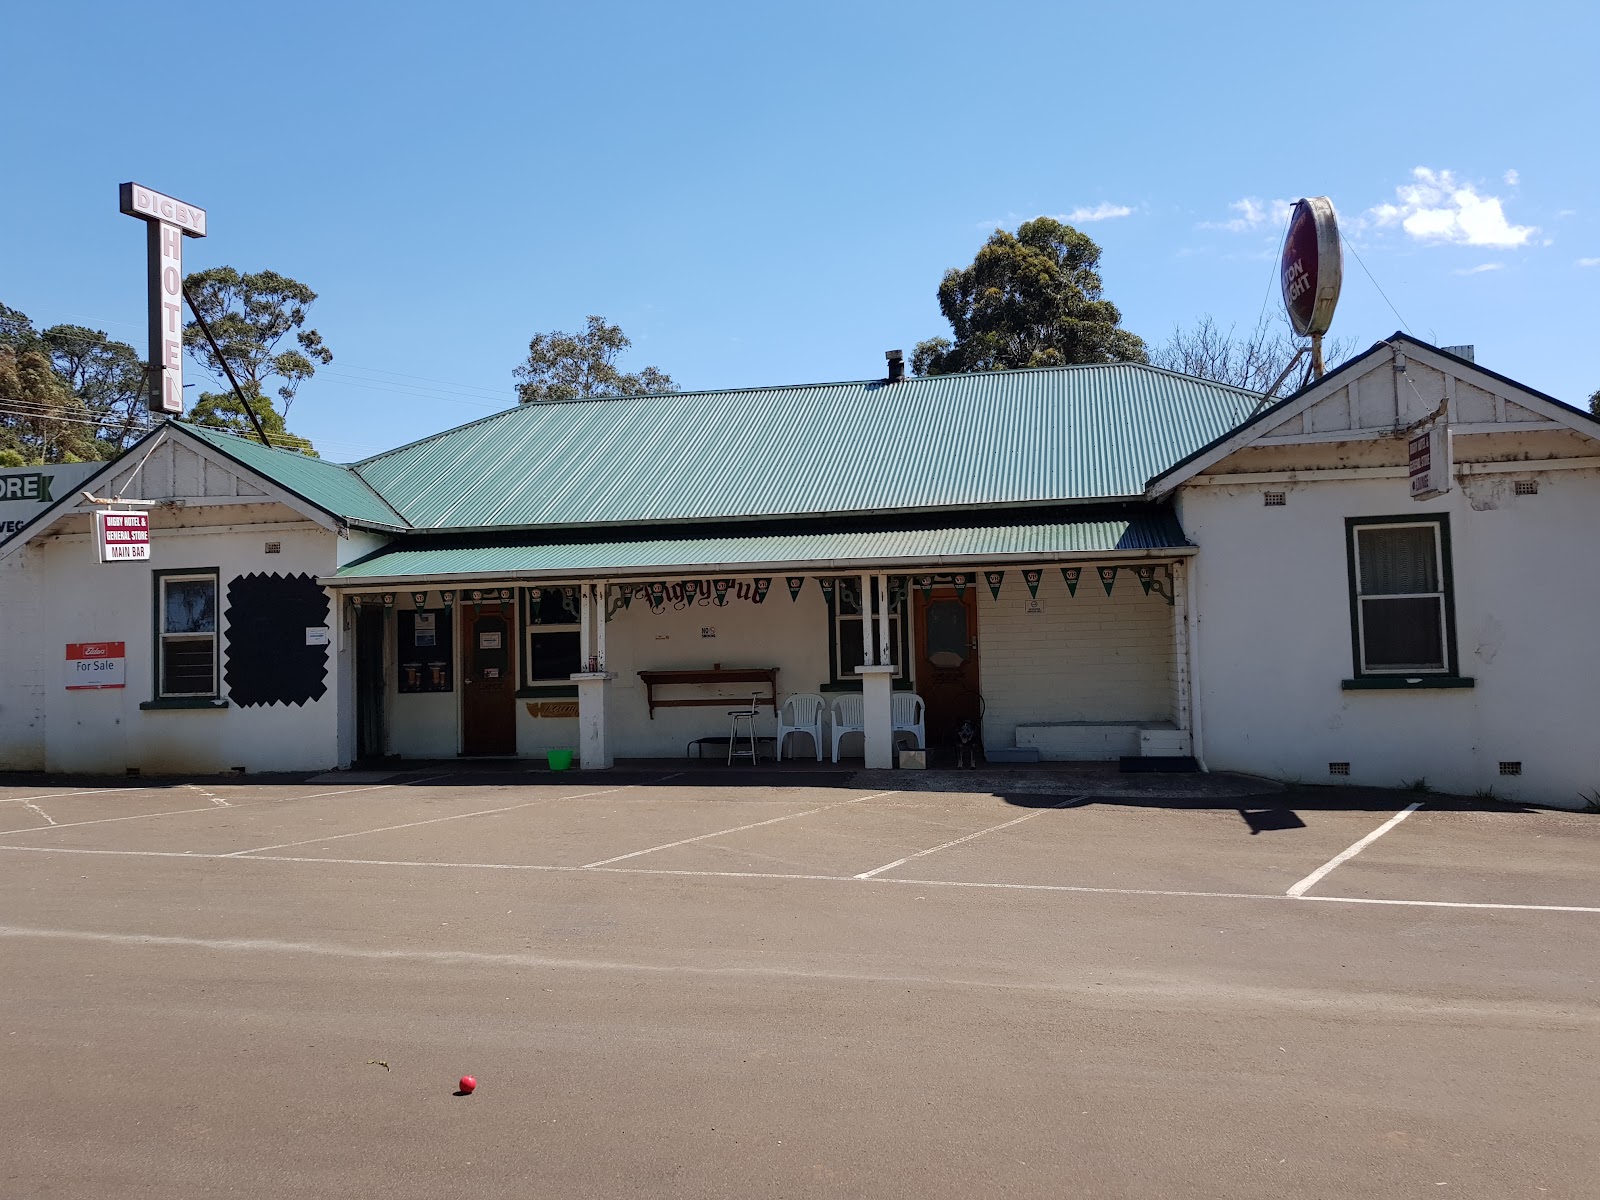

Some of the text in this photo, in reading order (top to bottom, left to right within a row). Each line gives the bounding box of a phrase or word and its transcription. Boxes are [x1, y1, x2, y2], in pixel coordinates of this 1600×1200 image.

[138, 189, 202, 229] DIGBY
[163, 227, 180, 408] HOTEL
[106, 516, 123, 527] DIGBY
[124, 516, 140, 527] HOTEL
[106, 530, 148, 541] GENERAL STORE
[111, 546, 145, 558] MAIN BAR
[76, 660, 114, 671] For Sale
